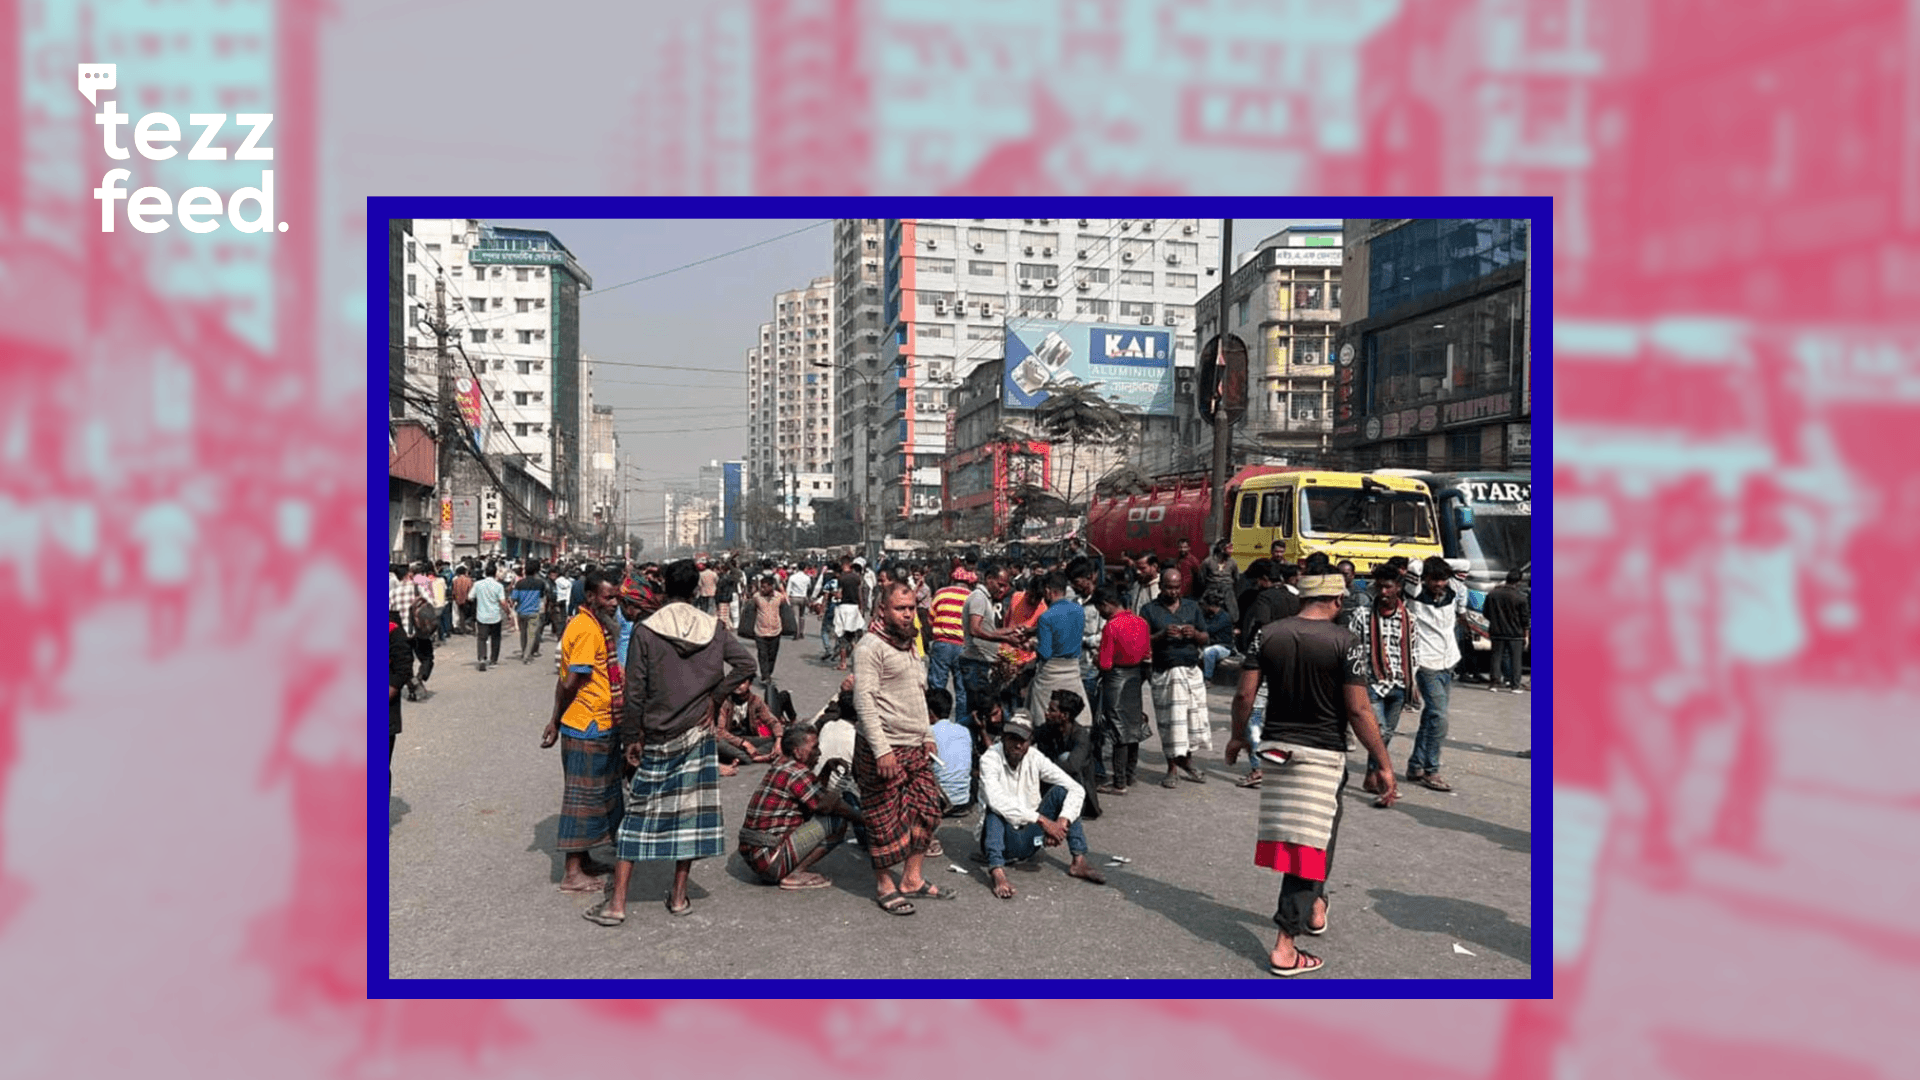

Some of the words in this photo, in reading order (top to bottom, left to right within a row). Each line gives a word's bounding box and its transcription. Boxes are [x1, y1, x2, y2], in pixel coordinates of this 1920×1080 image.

[1105, 334, 1155, 359] KAI
[1091, 366, 1166, 378] ALUMINIUM
[1456, 480, 1523, 503] STAR
